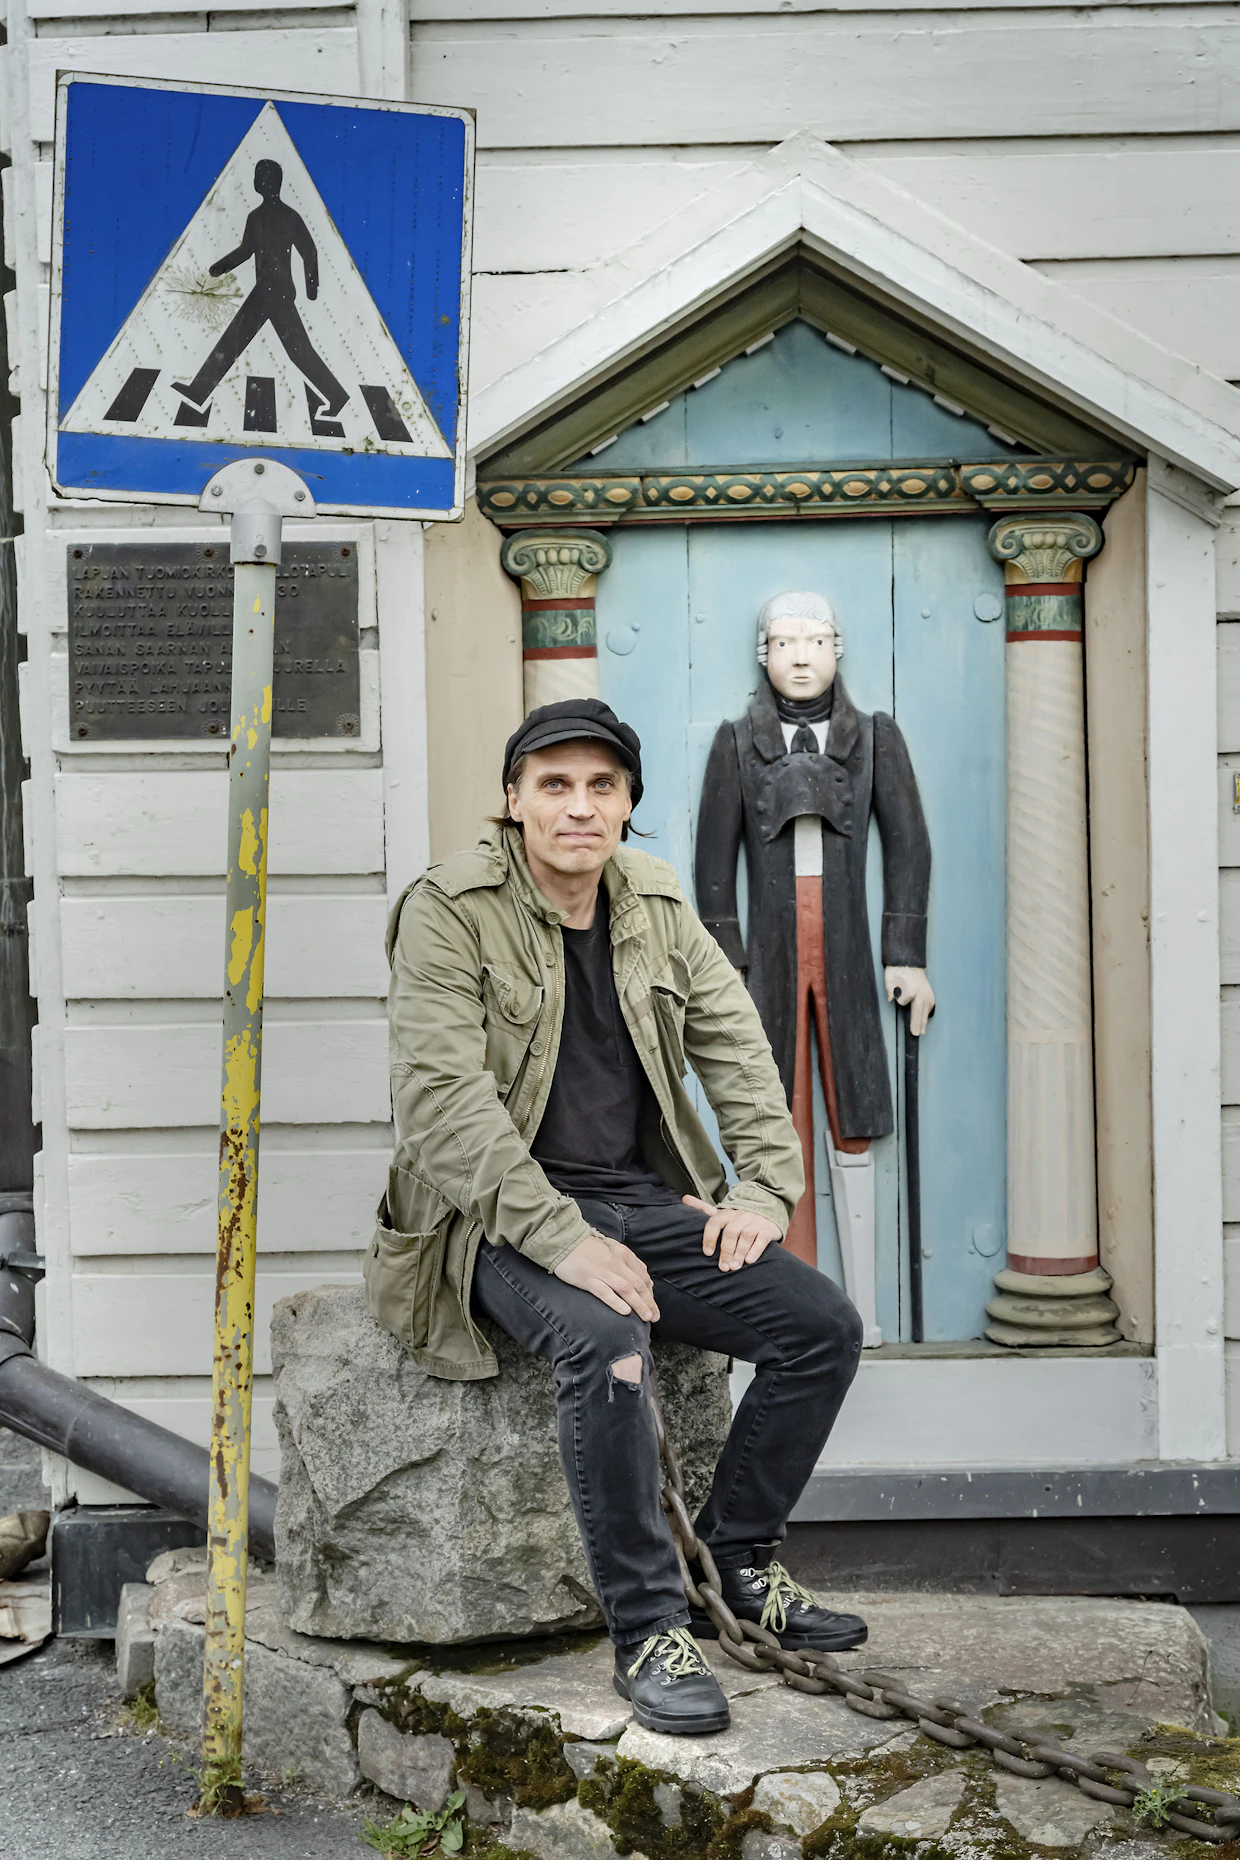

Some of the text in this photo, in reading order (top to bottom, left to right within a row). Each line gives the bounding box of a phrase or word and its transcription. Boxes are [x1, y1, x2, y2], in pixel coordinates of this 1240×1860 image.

[72, 566, 129, 581] LAPUAN
[135, 564, 235, 581] TUOMIOKIRKO
[74, 583, 300, 599] RAKENNETTU VUONN 30
[73, 602, 234, 618] KUULUTTAA KUOLL
[73, 621, 233, 637] ILMOITTAA ELÄVILL
[74, 642, 126, 657] SANAN
[135, 641, 210, 656] SAARNAN
[74, 658, 346, 676] VAIVAISPOIKA TAPUL UURELLA
[75, 678, 232, 695] PYYTÄÄ LAHJAANN
[75, 699, 187, 714] PUUTTEESEEN
